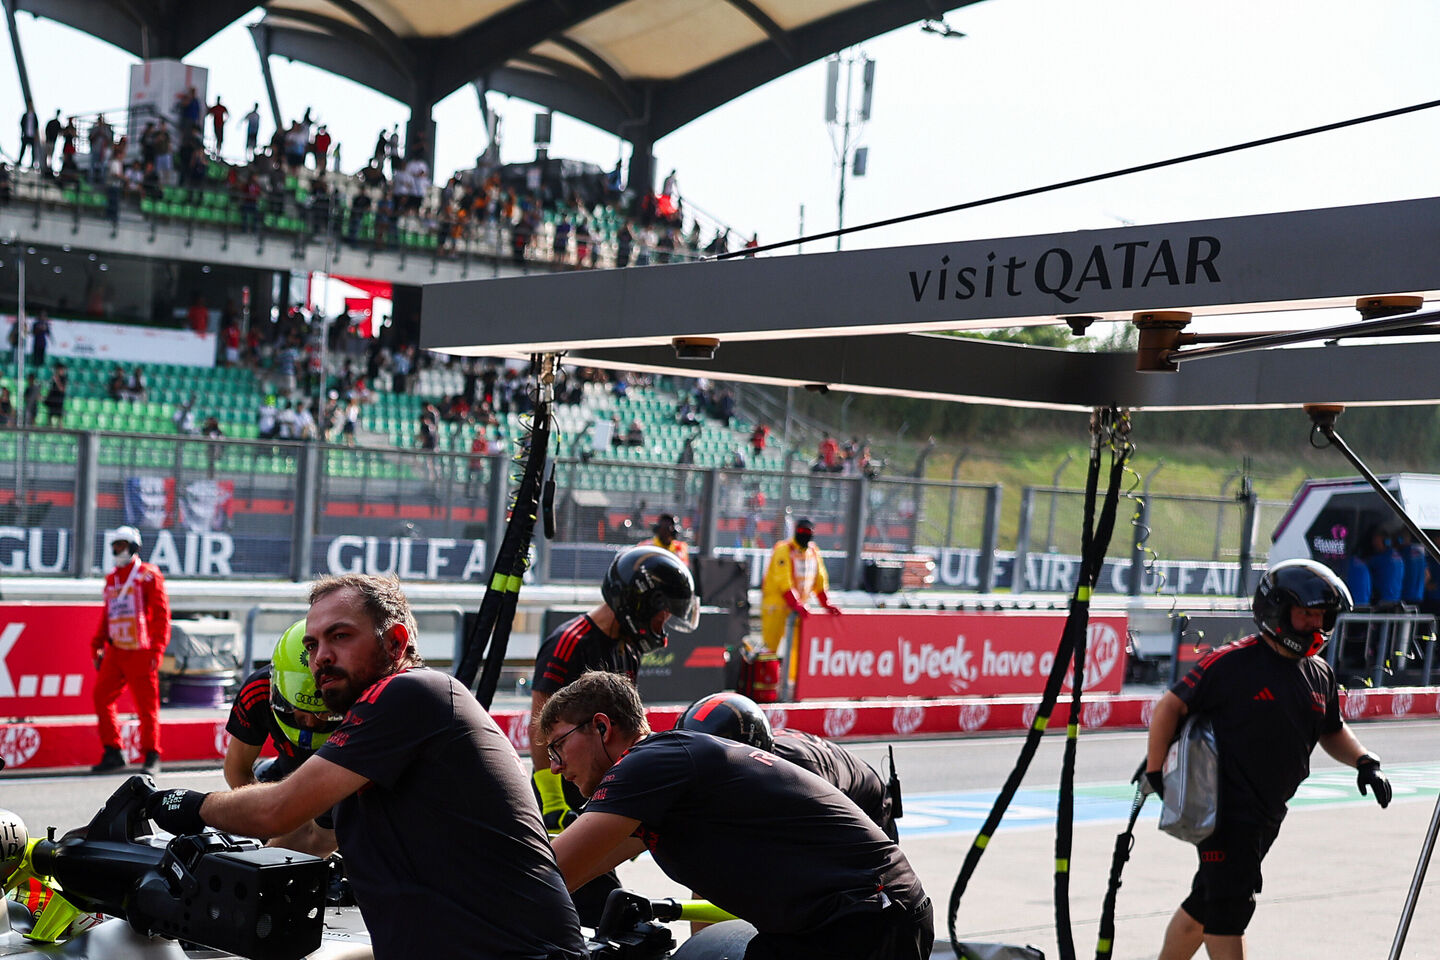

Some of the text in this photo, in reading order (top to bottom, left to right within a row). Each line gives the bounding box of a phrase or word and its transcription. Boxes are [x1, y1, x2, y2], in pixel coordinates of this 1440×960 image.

[148, 529, 235, 576] AIR
[326, 534, 457, 579] GULF
[810, 637, 873, 677] Have
[877, 651, 894, 677] a
[982, 640, 1040, 677] have
